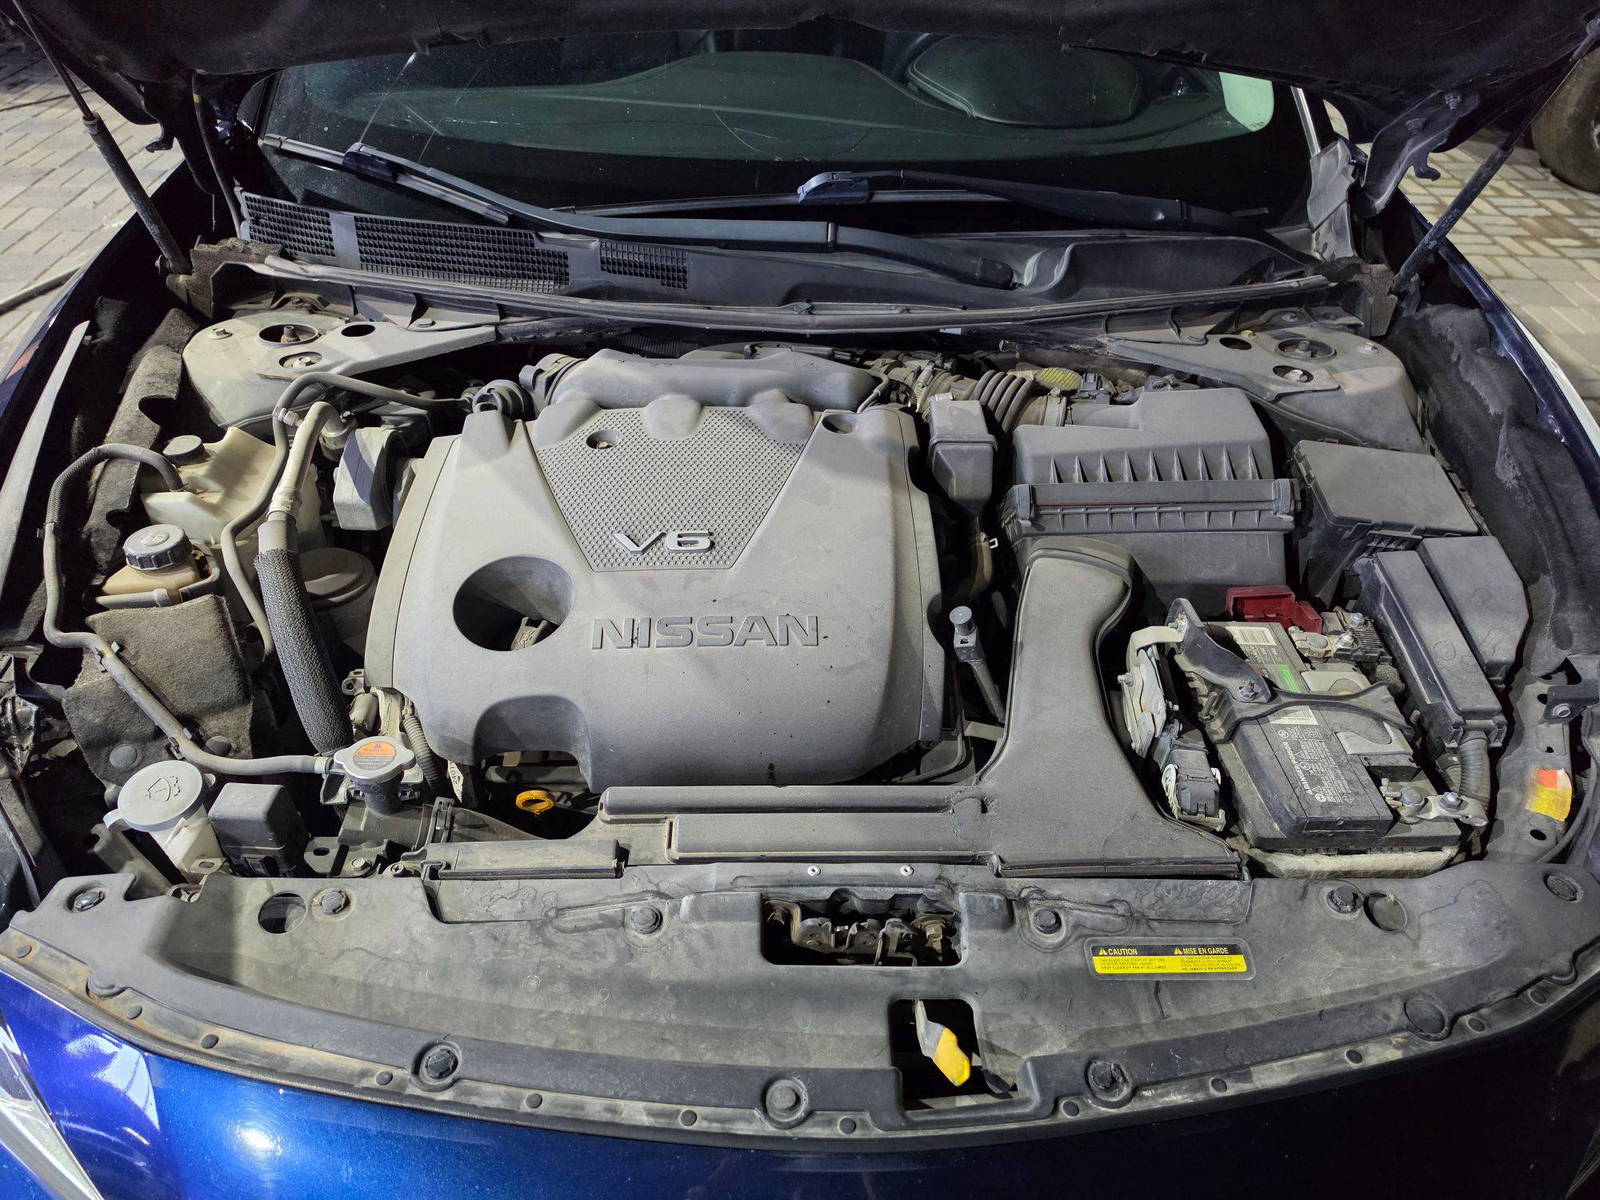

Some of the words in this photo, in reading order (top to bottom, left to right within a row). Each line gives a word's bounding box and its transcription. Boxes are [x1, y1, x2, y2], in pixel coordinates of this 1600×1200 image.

[609, 530, 714, 554] V6
[592, 615, 819, 650] NISSAN
[1107, 948, 1138, 956] CAUTION
[1182, 947, 1198, 955] MISE
